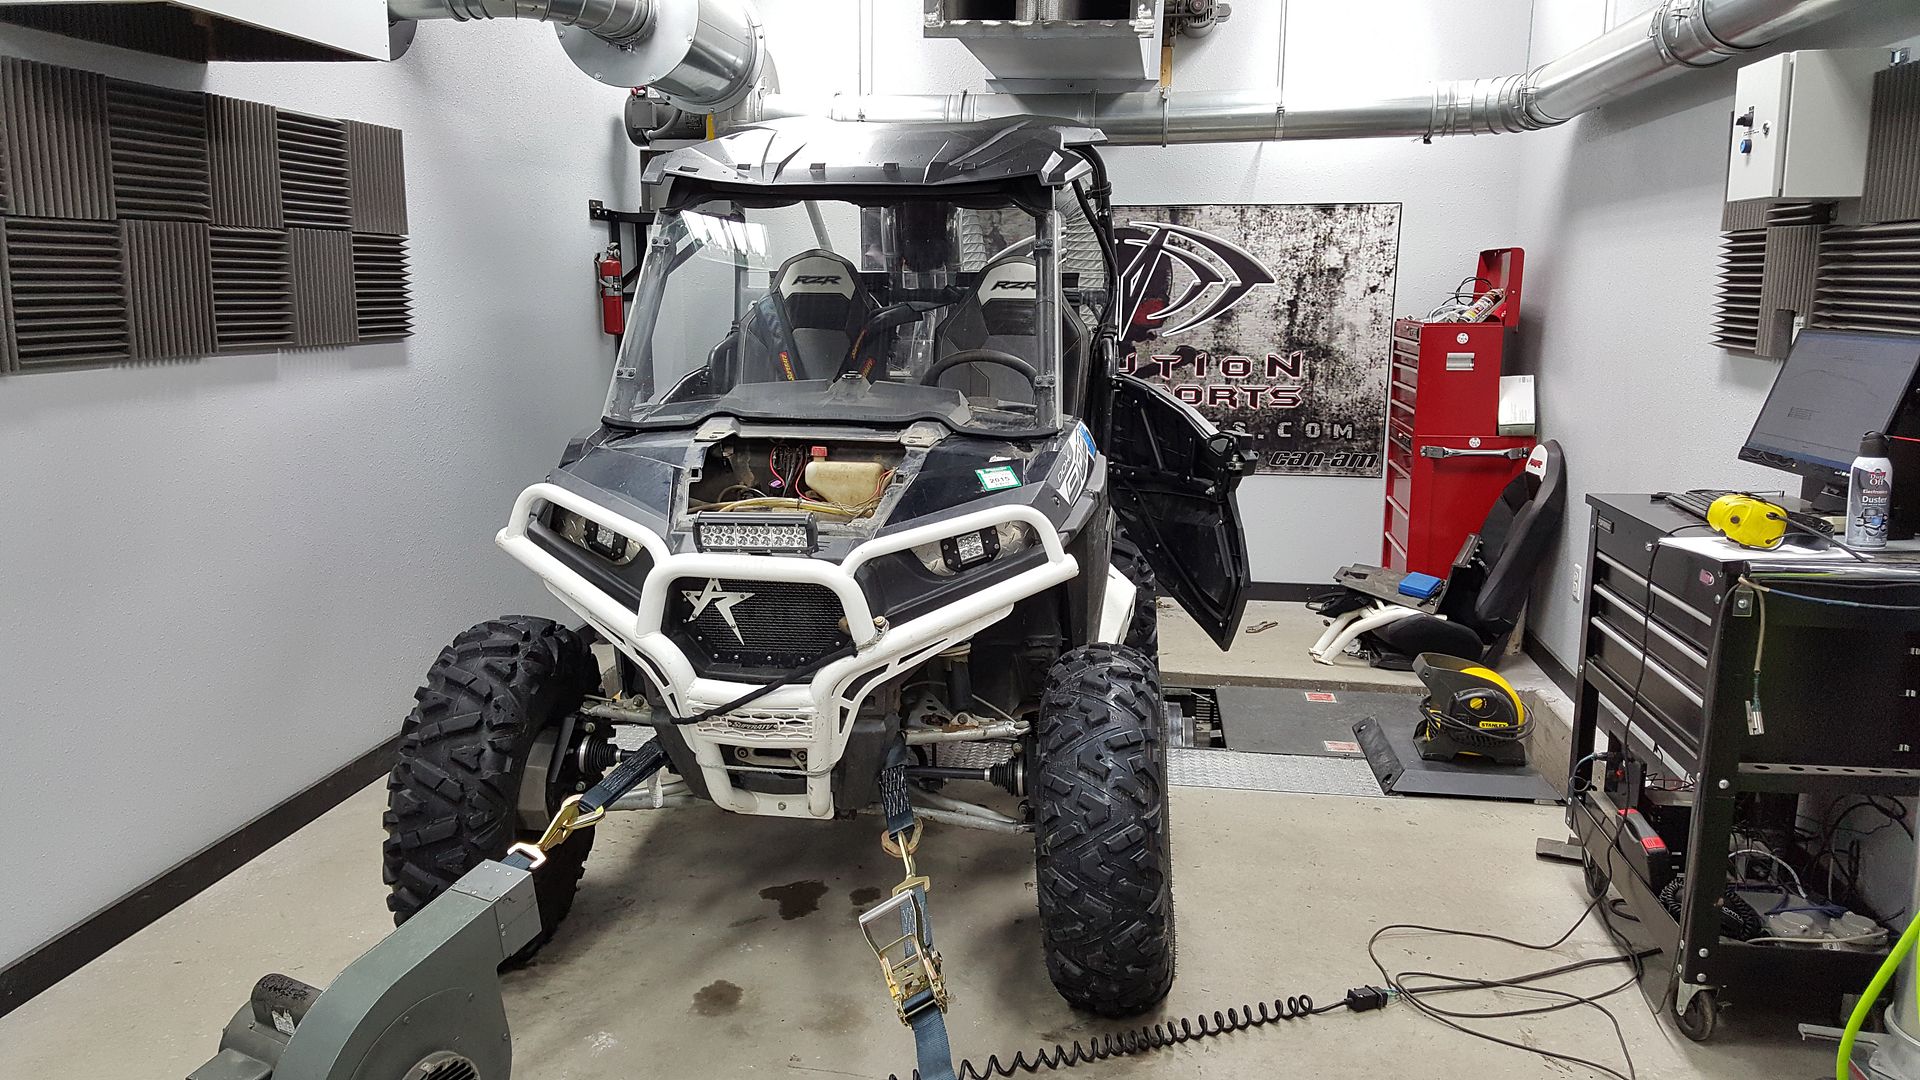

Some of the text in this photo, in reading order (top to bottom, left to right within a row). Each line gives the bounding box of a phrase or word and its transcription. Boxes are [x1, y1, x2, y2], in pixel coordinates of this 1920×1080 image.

[792, 275, 842, 286] RZR
[1156, 384, 1302, 409] ORTS
[1269, 450, 1379, 469] can-am
[989, 476, 1011, 484] 2015
[1862, 495, 1888, 503] Duster
